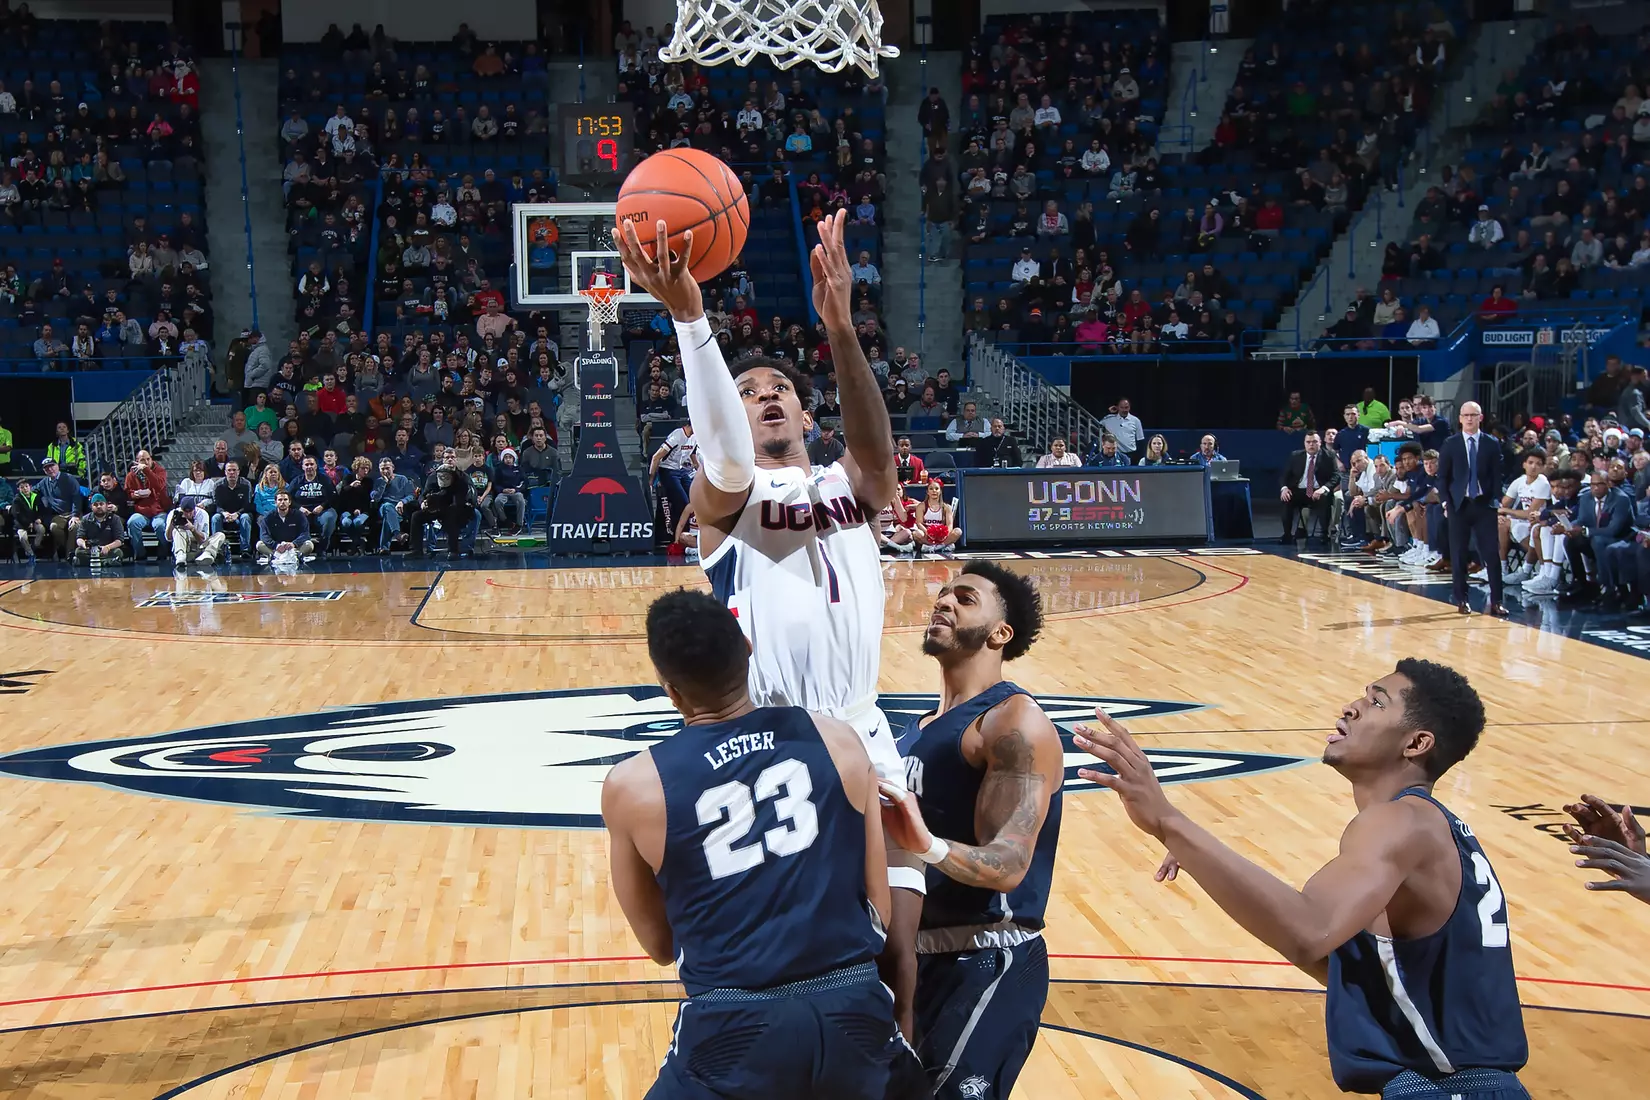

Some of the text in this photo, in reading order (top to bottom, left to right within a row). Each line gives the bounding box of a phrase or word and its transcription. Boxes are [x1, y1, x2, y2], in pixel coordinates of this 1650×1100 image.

[577, 116, 622, 136] 17:53
[597, 138, 618, 171] 9
[1484, 333, 1531, 343] BUD LIGHT
[581, 358, 613, 366] SPALDING
[1028, 480, 1141, 504] UCONN
[760, 494, 865, 532] UCNN
[550, 523, 653, 539] TRAVELERS
[1049, 522, 1085, 531] SPORTS
[1088, 521, 1134, 530] NETWORK
[880, 547, 1263, 562] USKIES
[818, 541, 841, 603] 1
[704, 731, 775, 771] LESTER
[694, 756, 819, 881] 23
